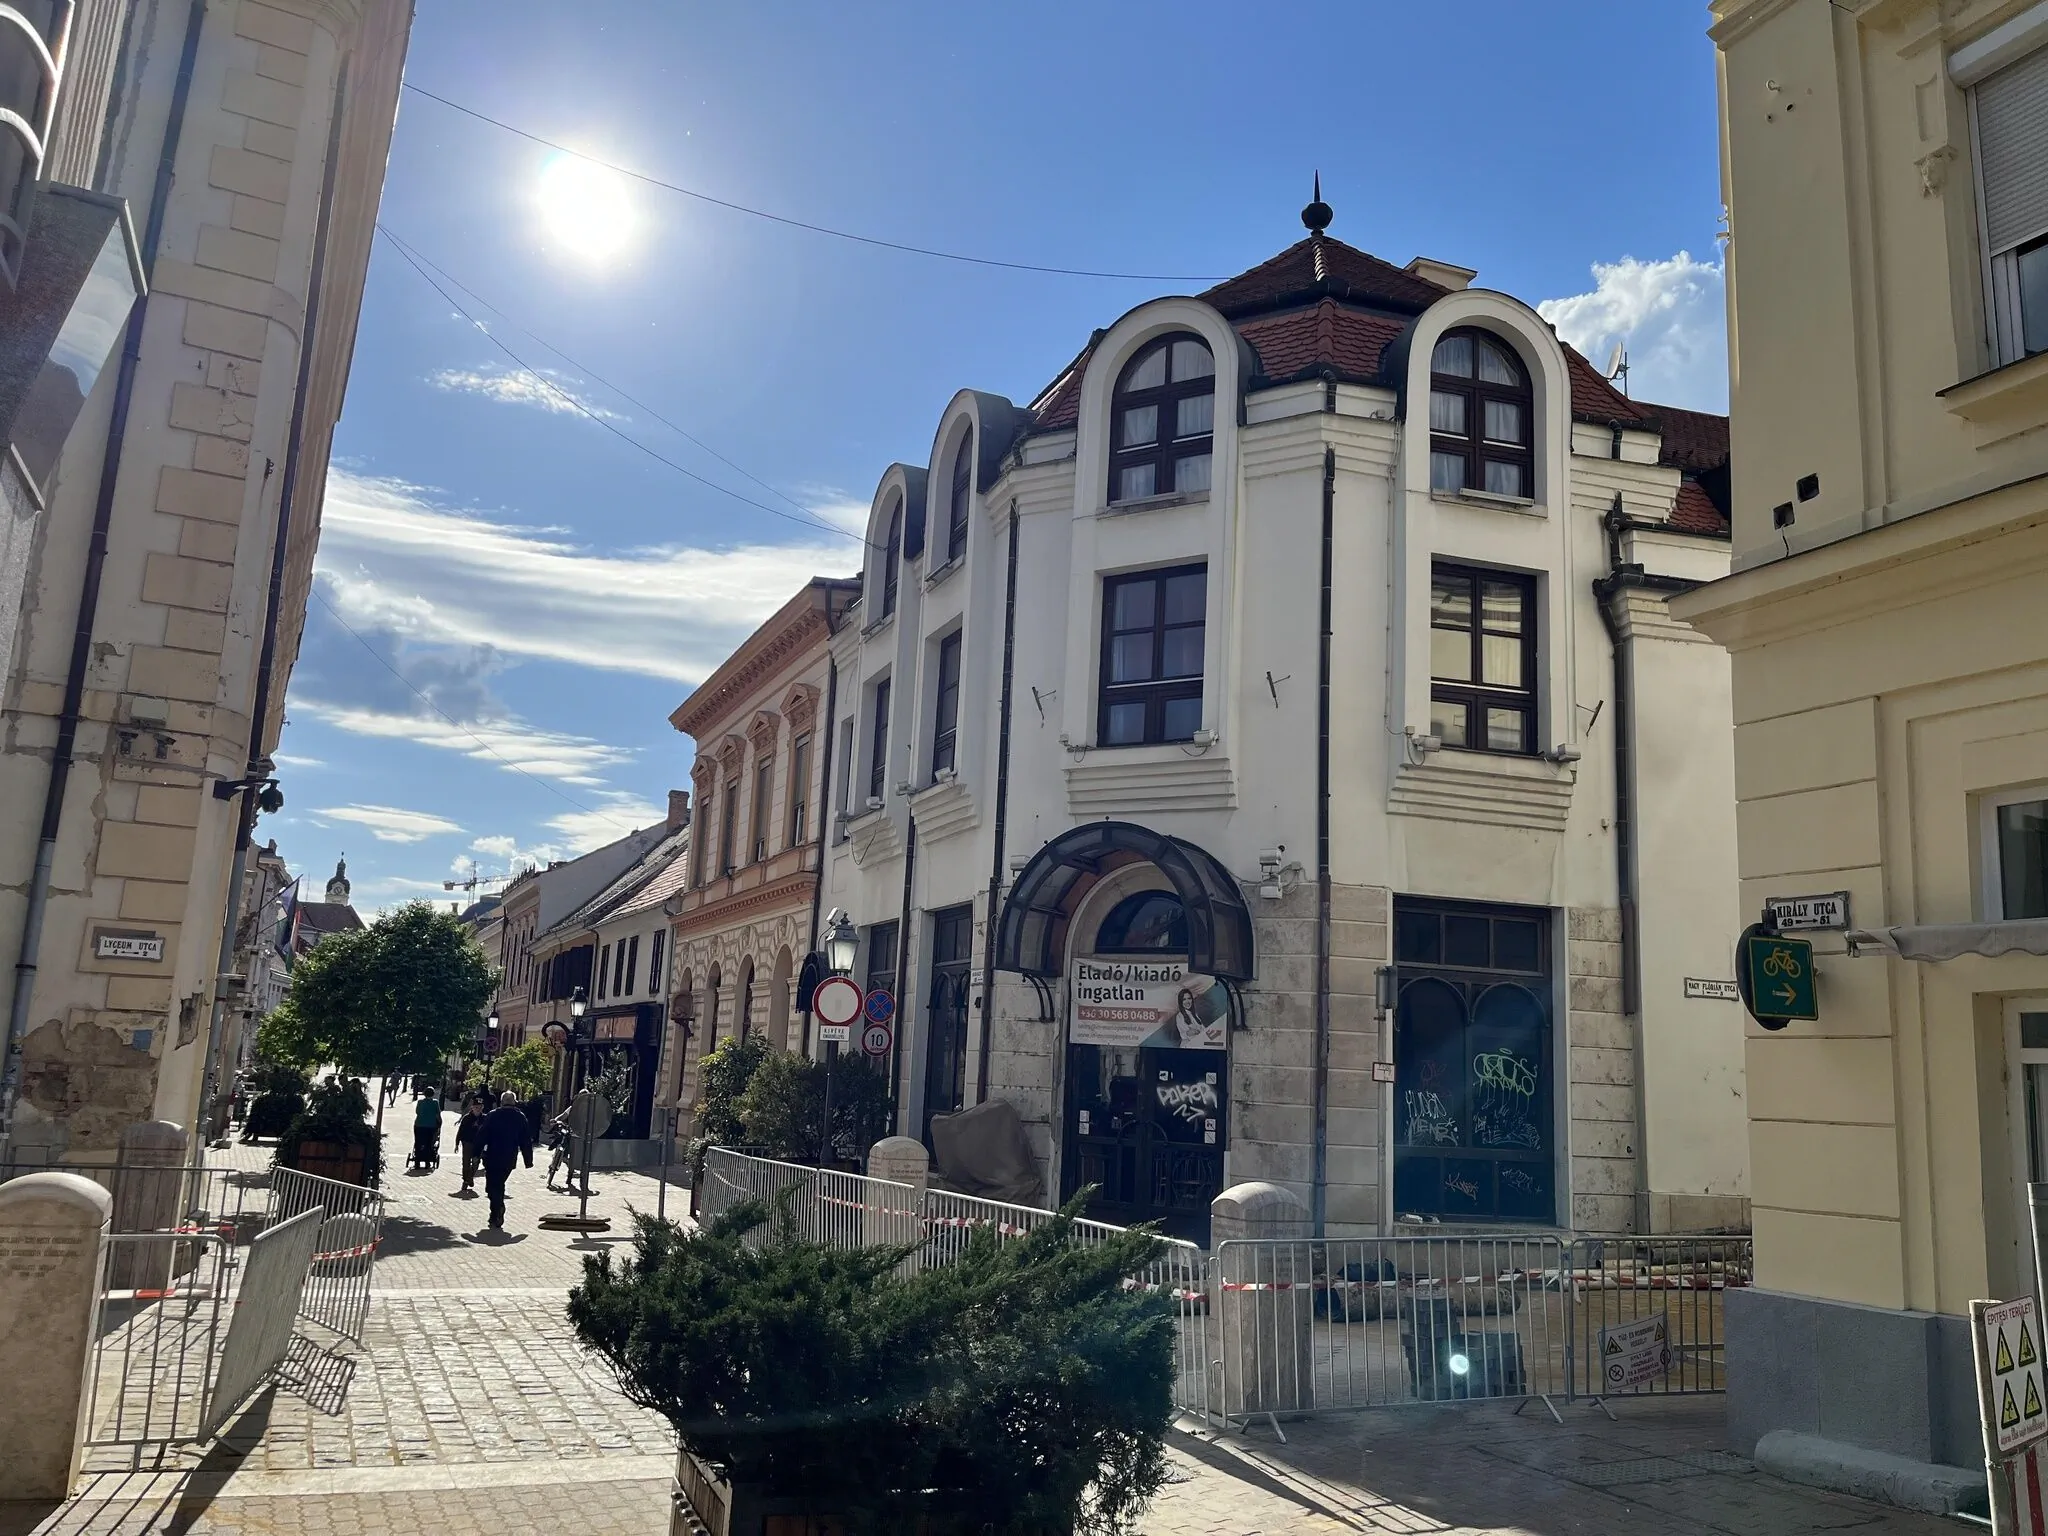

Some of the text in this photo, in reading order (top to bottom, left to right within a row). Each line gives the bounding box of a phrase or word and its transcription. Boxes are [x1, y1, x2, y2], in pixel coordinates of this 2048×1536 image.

[1777, 901, 1837, 918] KIRÁLY UTCA
[1781, 918, 1793, 927] 49
[104, 940, 156, 951] LYCEUM UTCA
[1079, 965, 1181, 982] Eladó/kiadó
[1078, 983, 1144, 1003] ingatlan
[1098, 1010, 1109, 1018] 30
[1111, 1010, 1128, 1020] 568
[1131, 1011, 1155, 1020] 0488
[871, 1034, 883, 1046] 10
